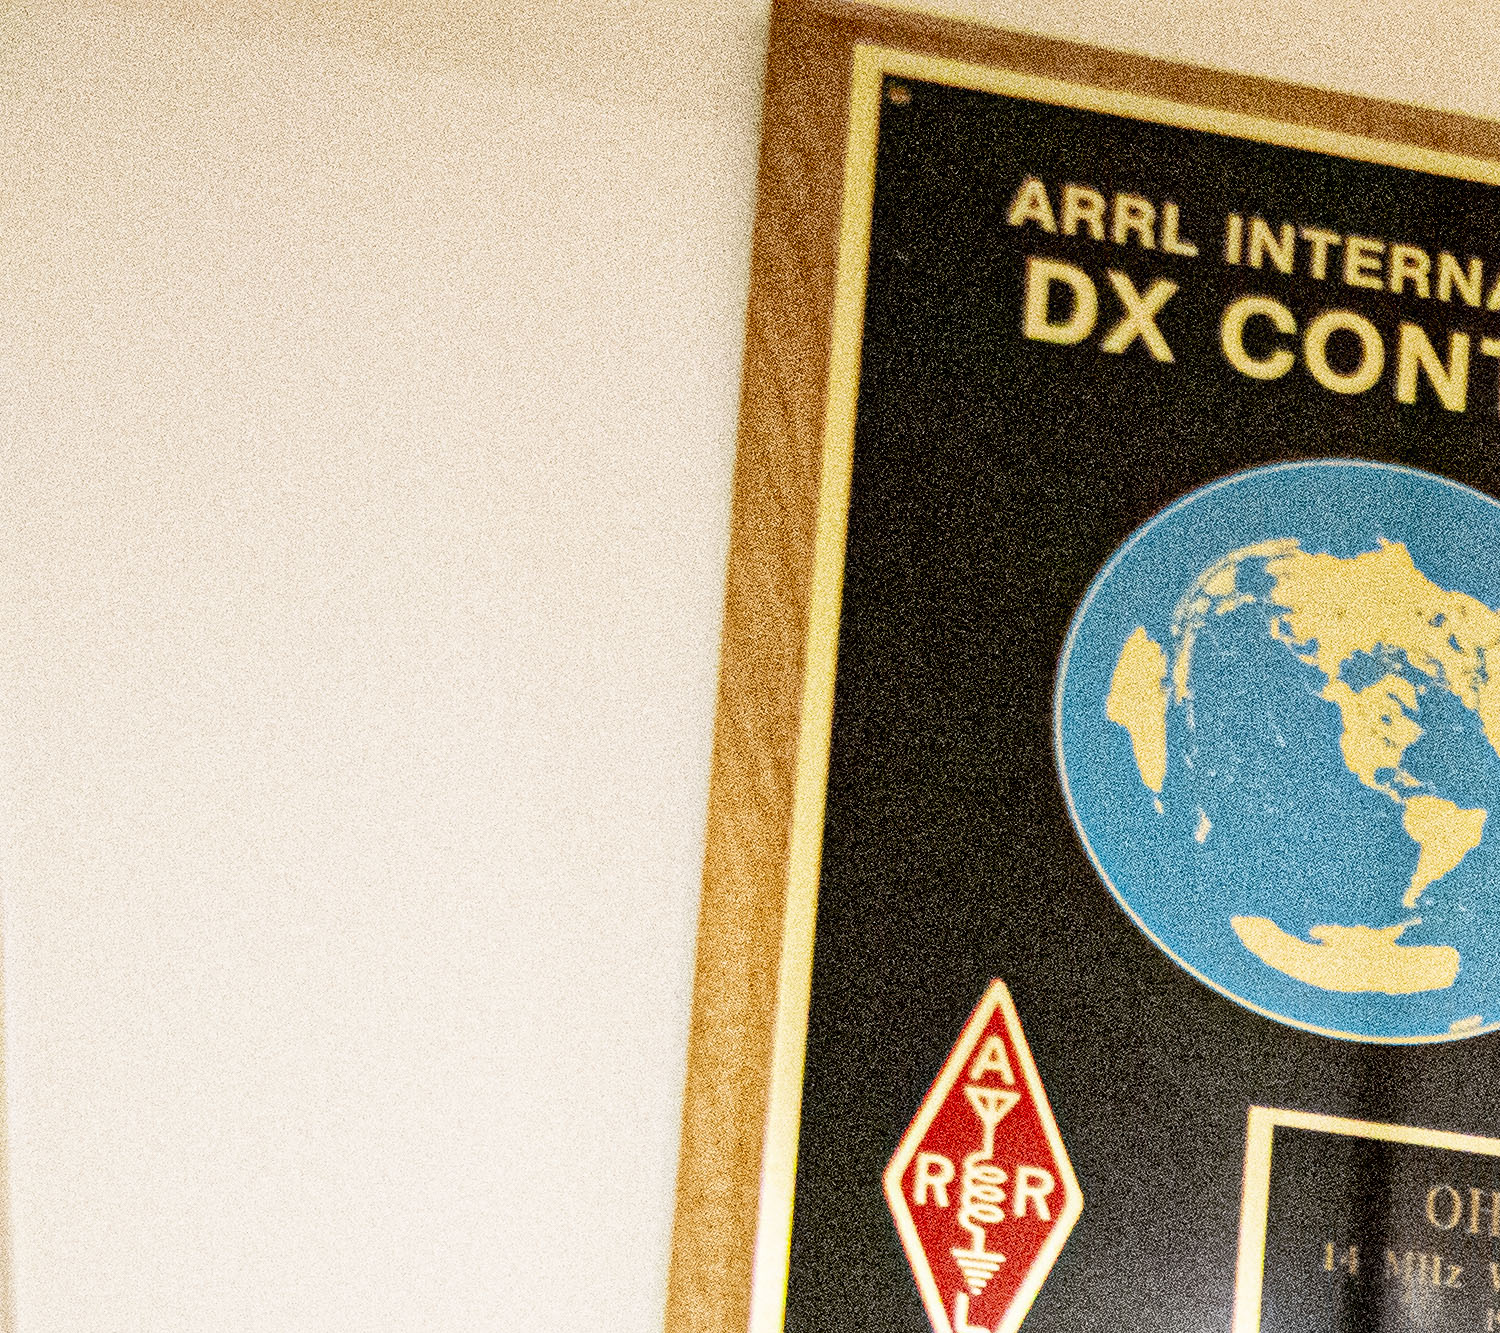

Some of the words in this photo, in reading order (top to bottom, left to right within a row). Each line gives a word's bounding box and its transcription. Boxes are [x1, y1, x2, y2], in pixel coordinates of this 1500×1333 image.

[1007, 176, 1198, 255] ARRL
[1020, 254, 1179, 364] DX
[1322, 1242, 1359, 1276] 14
[1385, 1247, 1464, 1290] MHz
